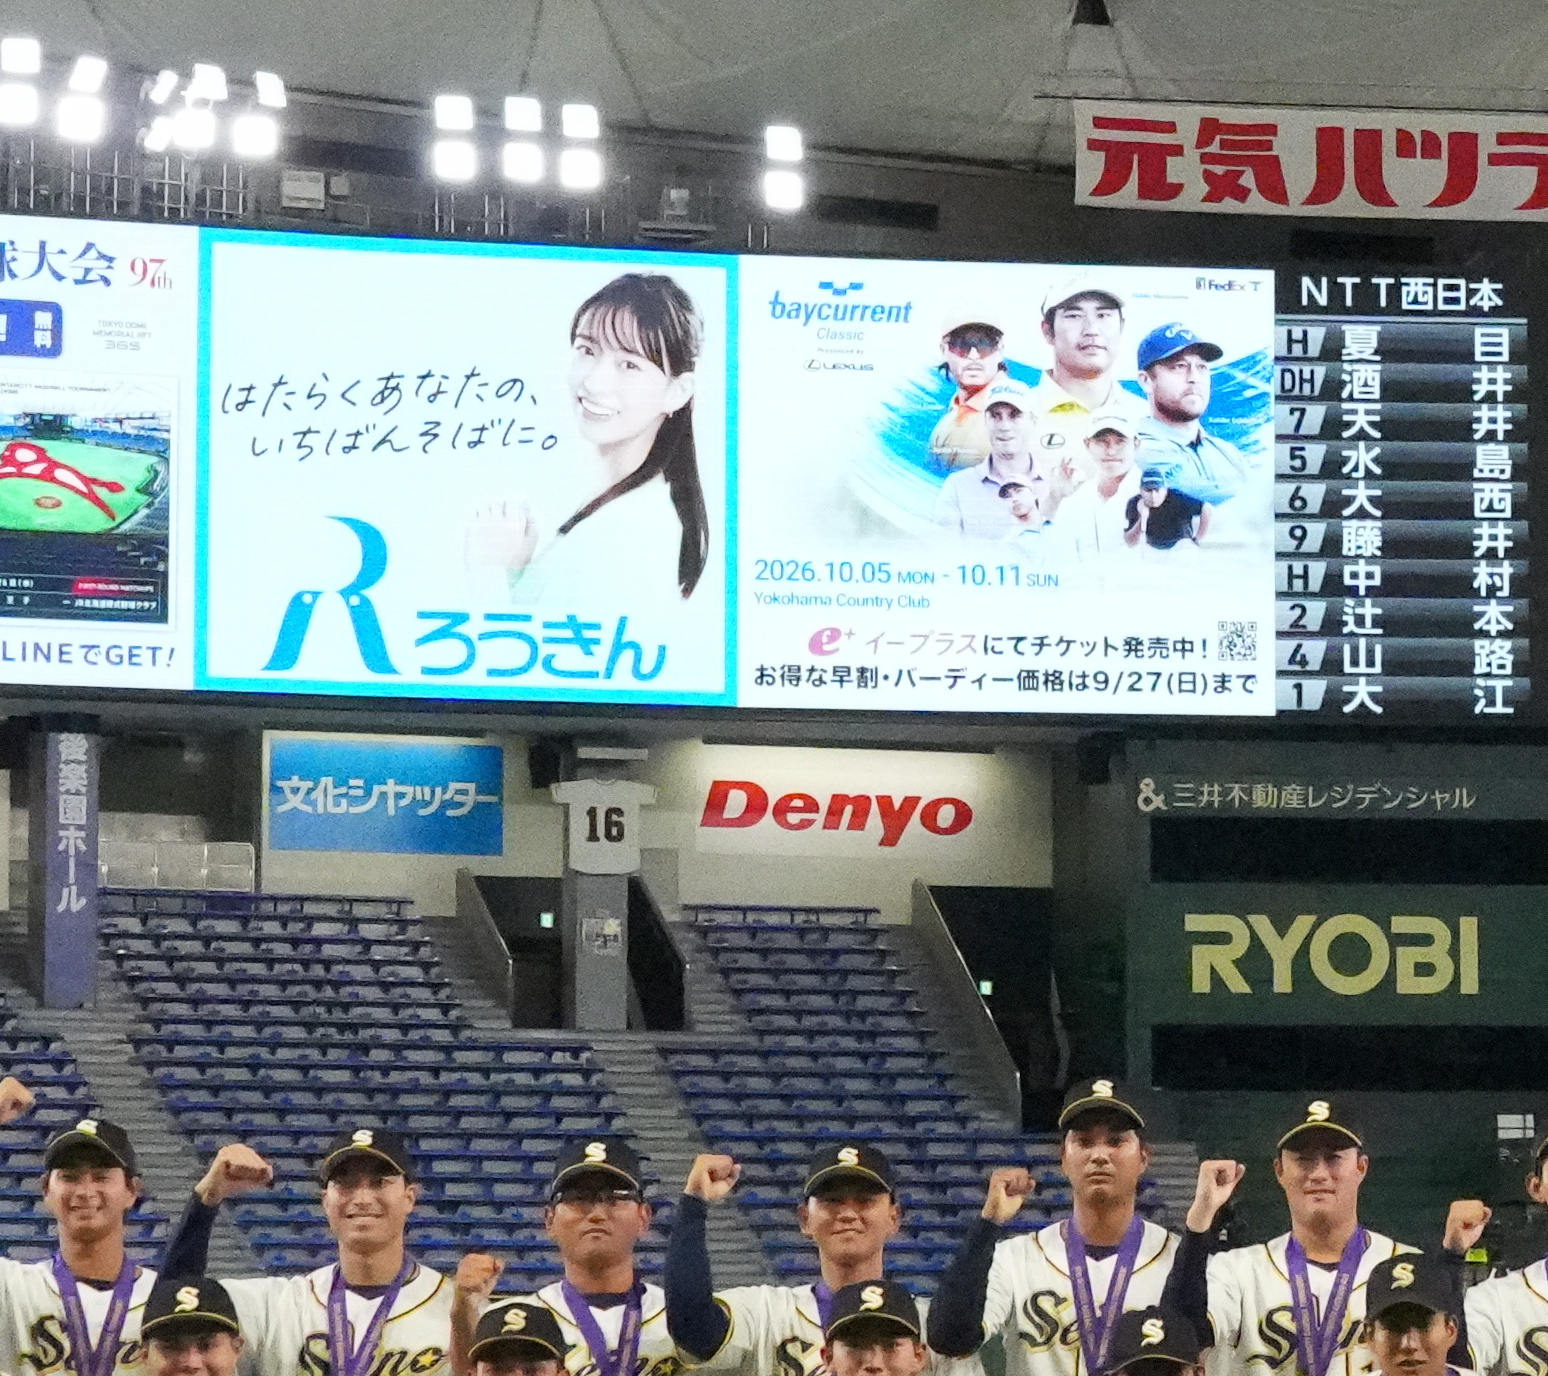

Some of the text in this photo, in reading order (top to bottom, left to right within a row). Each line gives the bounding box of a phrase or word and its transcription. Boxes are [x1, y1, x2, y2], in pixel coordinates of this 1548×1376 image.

[130, 255, 174, 291] 97th
[1209, 279, 1246, 292] FedEx
[769, 290, 913, 326] baycurrent
[34, 310, 53, 349] 無料
[816, 327, 865, 341] Classic
[1286, 329, 1309, 355] H
[823, 362, 874, 371] LEXUS
[221, 365, 539, 417] はたらくあなたの、
[1280, 369, 1315, 395] DH
[1289, 408, 1307, 433] 7
[251, 420, 558, 462] いちばんそばに。
[1289, 447, 1307, 473] 5
[1289, 484, 1308, 511] 6
[1289, 524, 1308, 551] 9
[755, 559, 1059, 588] 2026.10.05 MON 10.11 SUN
[1287, 564, 1309, 590] H
[754, 590, 931, 612] Yokohama Country Club
[1289, 603, 1308, 629] 2
[2, 639, 177, 669] LINEでGET!
[414, 610, 667, 681] ろうきん
[865, 632, 1208, 660] イープラスにてチケット発売中!
[1288, 642, 1309, 669] 4
[754, 664, 1259, 695] お得な早割・バーディー価格は9/27(日)まで
[1292, 682, 1304, 707] 1
[1172, 782, 1477, 812] 三井不動産レジデンシャル
[585, 806, 625, 843] 16
[699, 779, 974, 847] Denyo
[1184, 913, 1480, 996] RYOBI
